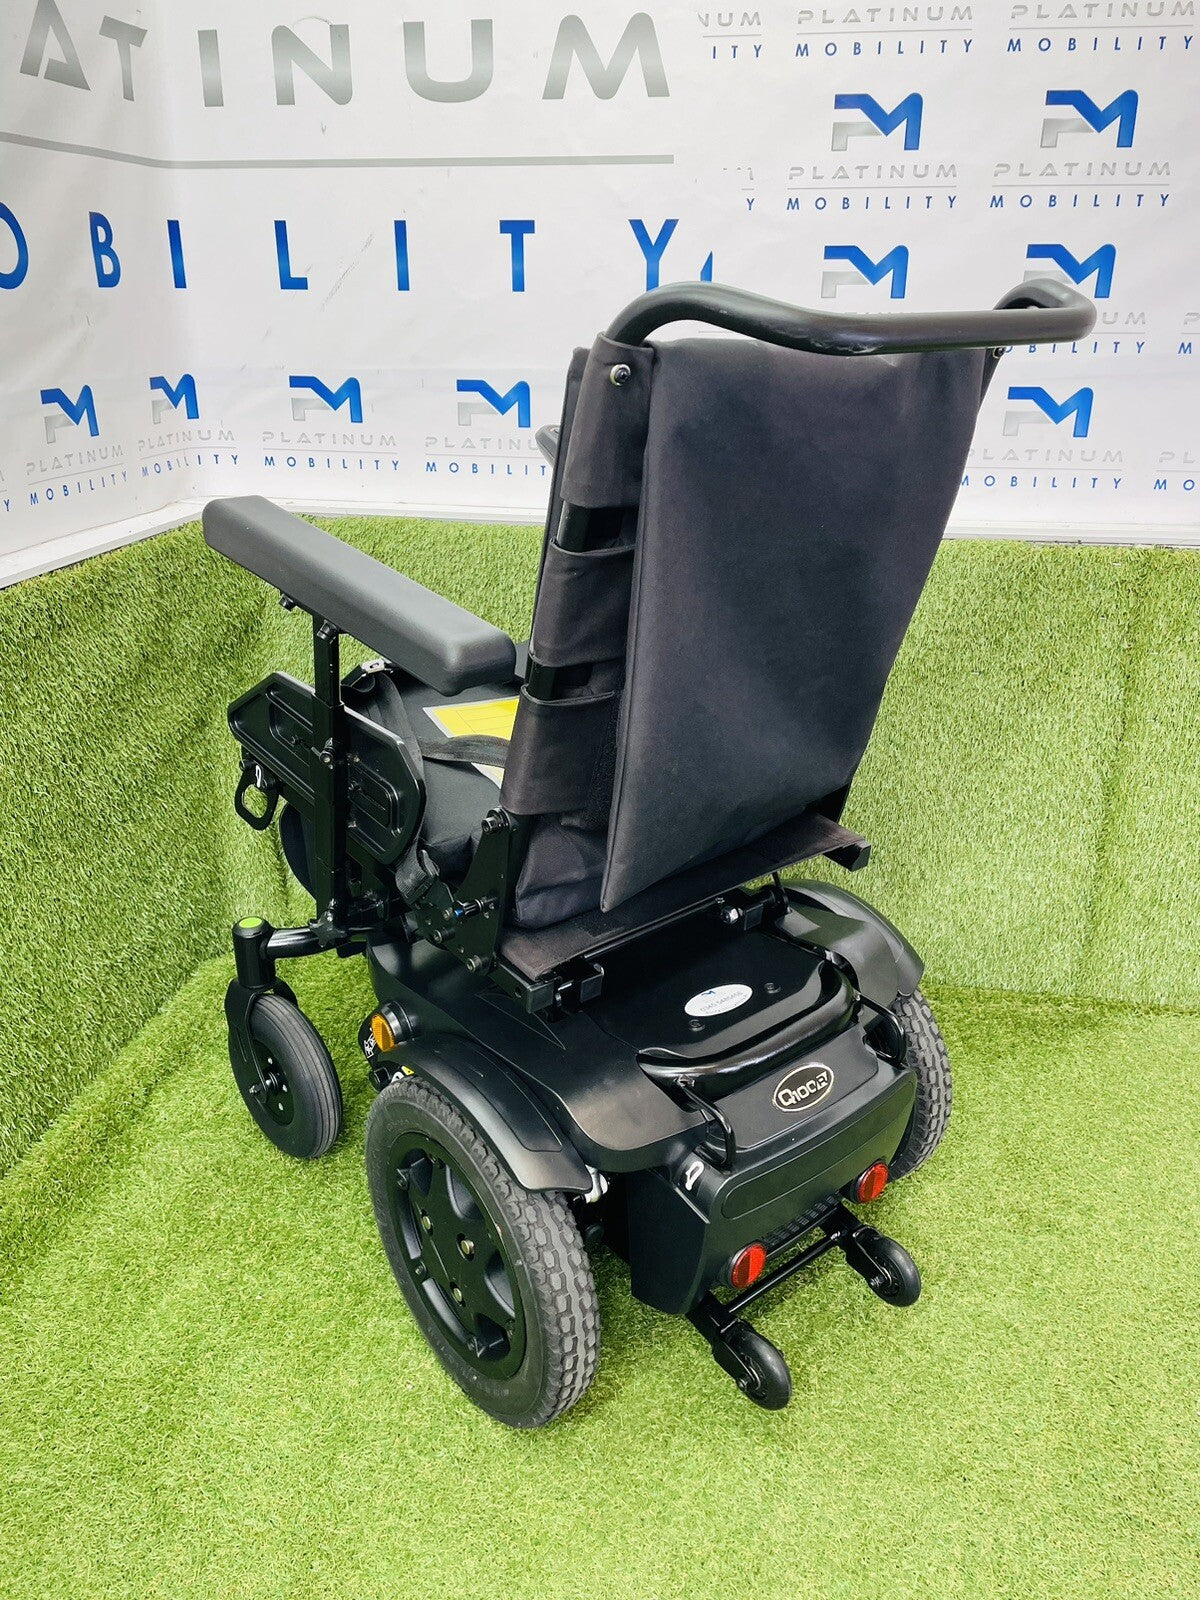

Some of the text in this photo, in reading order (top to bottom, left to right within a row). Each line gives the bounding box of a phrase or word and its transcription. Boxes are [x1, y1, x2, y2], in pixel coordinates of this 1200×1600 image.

[797, 6, 973, 25] PLATINUM
[1010, 0, 1196, 19] PLATINUM
[795, 39, 973, 57] MOBILITY
[1007, 35, 1194, 52] MOBILITY
[789, 163, 958, 181] PLATINUM
[993, 161, 1171, 177] PLATINUM
[786, 195, 957, 211] MOBILITY
[990, 193, 1170, 209] MOBILITY
[137, 430, 235, 452] PLATINUM
[262, 431, 397, 447] PLATINUM
[26, 444, 125, 476] PLATINUM
[141, 454, 238, 477] MOBILITY
[264, 455, 399, 471] MOBILITY
[30, 470, 128, 505] MOBILITY
